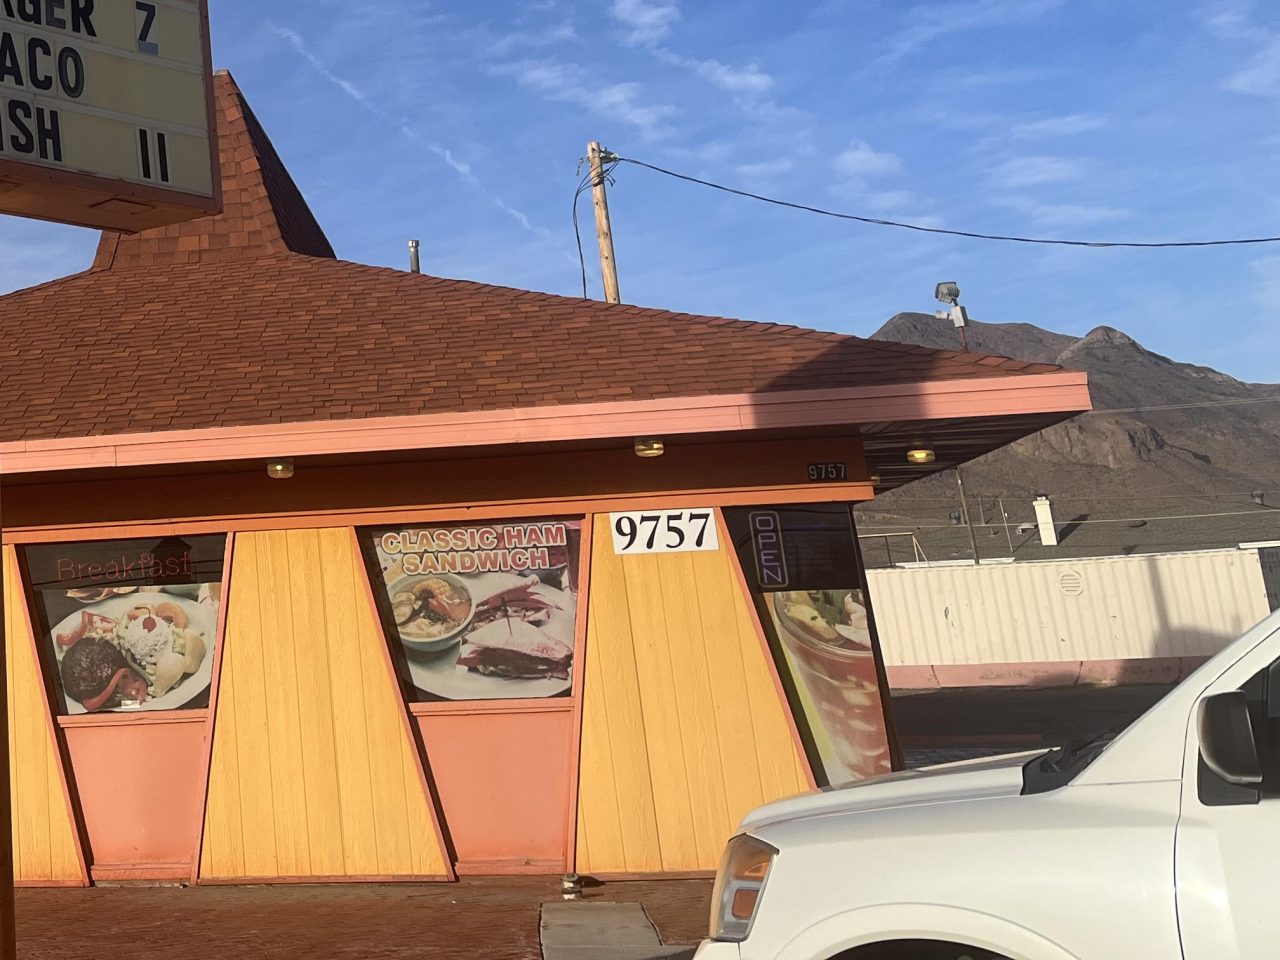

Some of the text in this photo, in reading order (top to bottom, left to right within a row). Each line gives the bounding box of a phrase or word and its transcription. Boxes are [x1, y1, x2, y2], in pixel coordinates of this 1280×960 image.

[135, 1, 157, 42] 7
[808, 464, 846, 481] 9757
[381, 524, 567, 554] CLASSIC HAM
[615, 511, 711, 551] 9757
[402, 548, 550, 575] SANDWICH
[754, 515, 784, 585] OPEN
[56, 551, 193, 583] Breakfast
